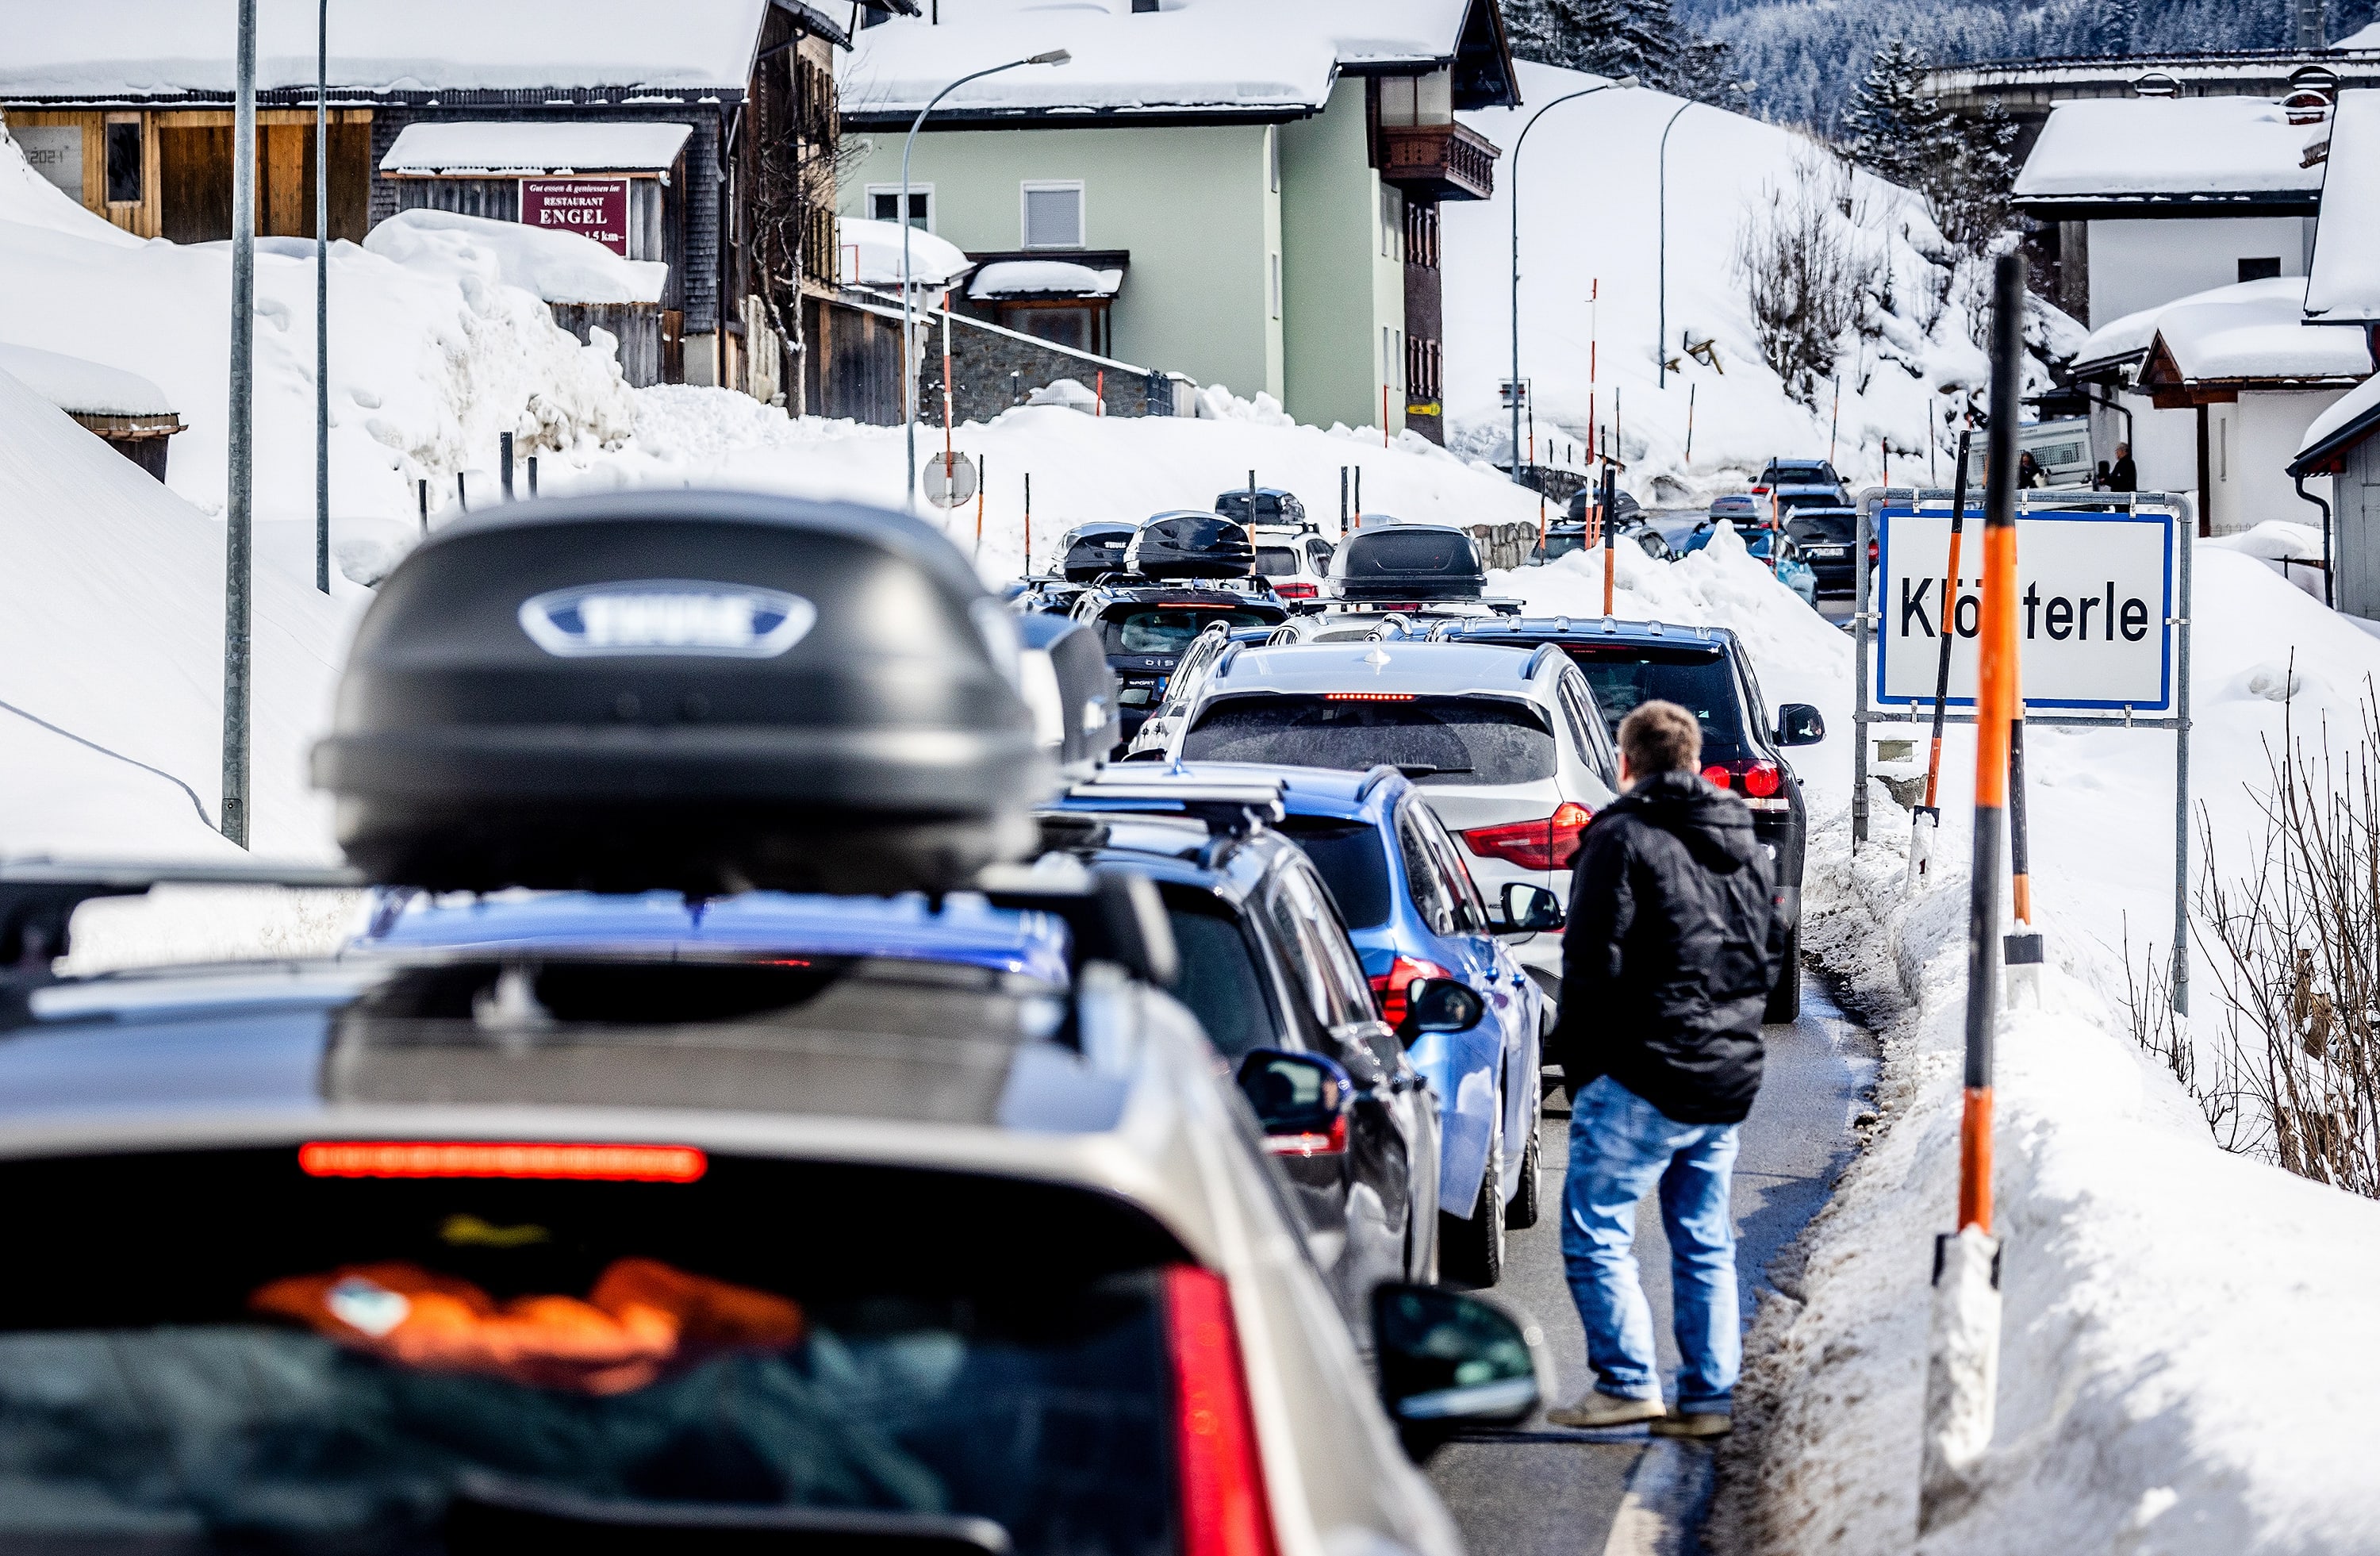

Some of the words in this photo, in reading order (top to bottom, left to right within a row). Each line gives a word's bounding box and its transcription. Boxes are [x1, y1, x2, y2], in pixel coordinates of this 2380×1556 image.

[30, 150, 63, 164] 2021
[529, 184, 543, 193] Gut
[566, 184, 573, 193] &
[543, 197, 605, 206] RESTAURANT
[539, 209, 608, 225] ENGEL
[1901, 578, 2148, 641] Klöterle
